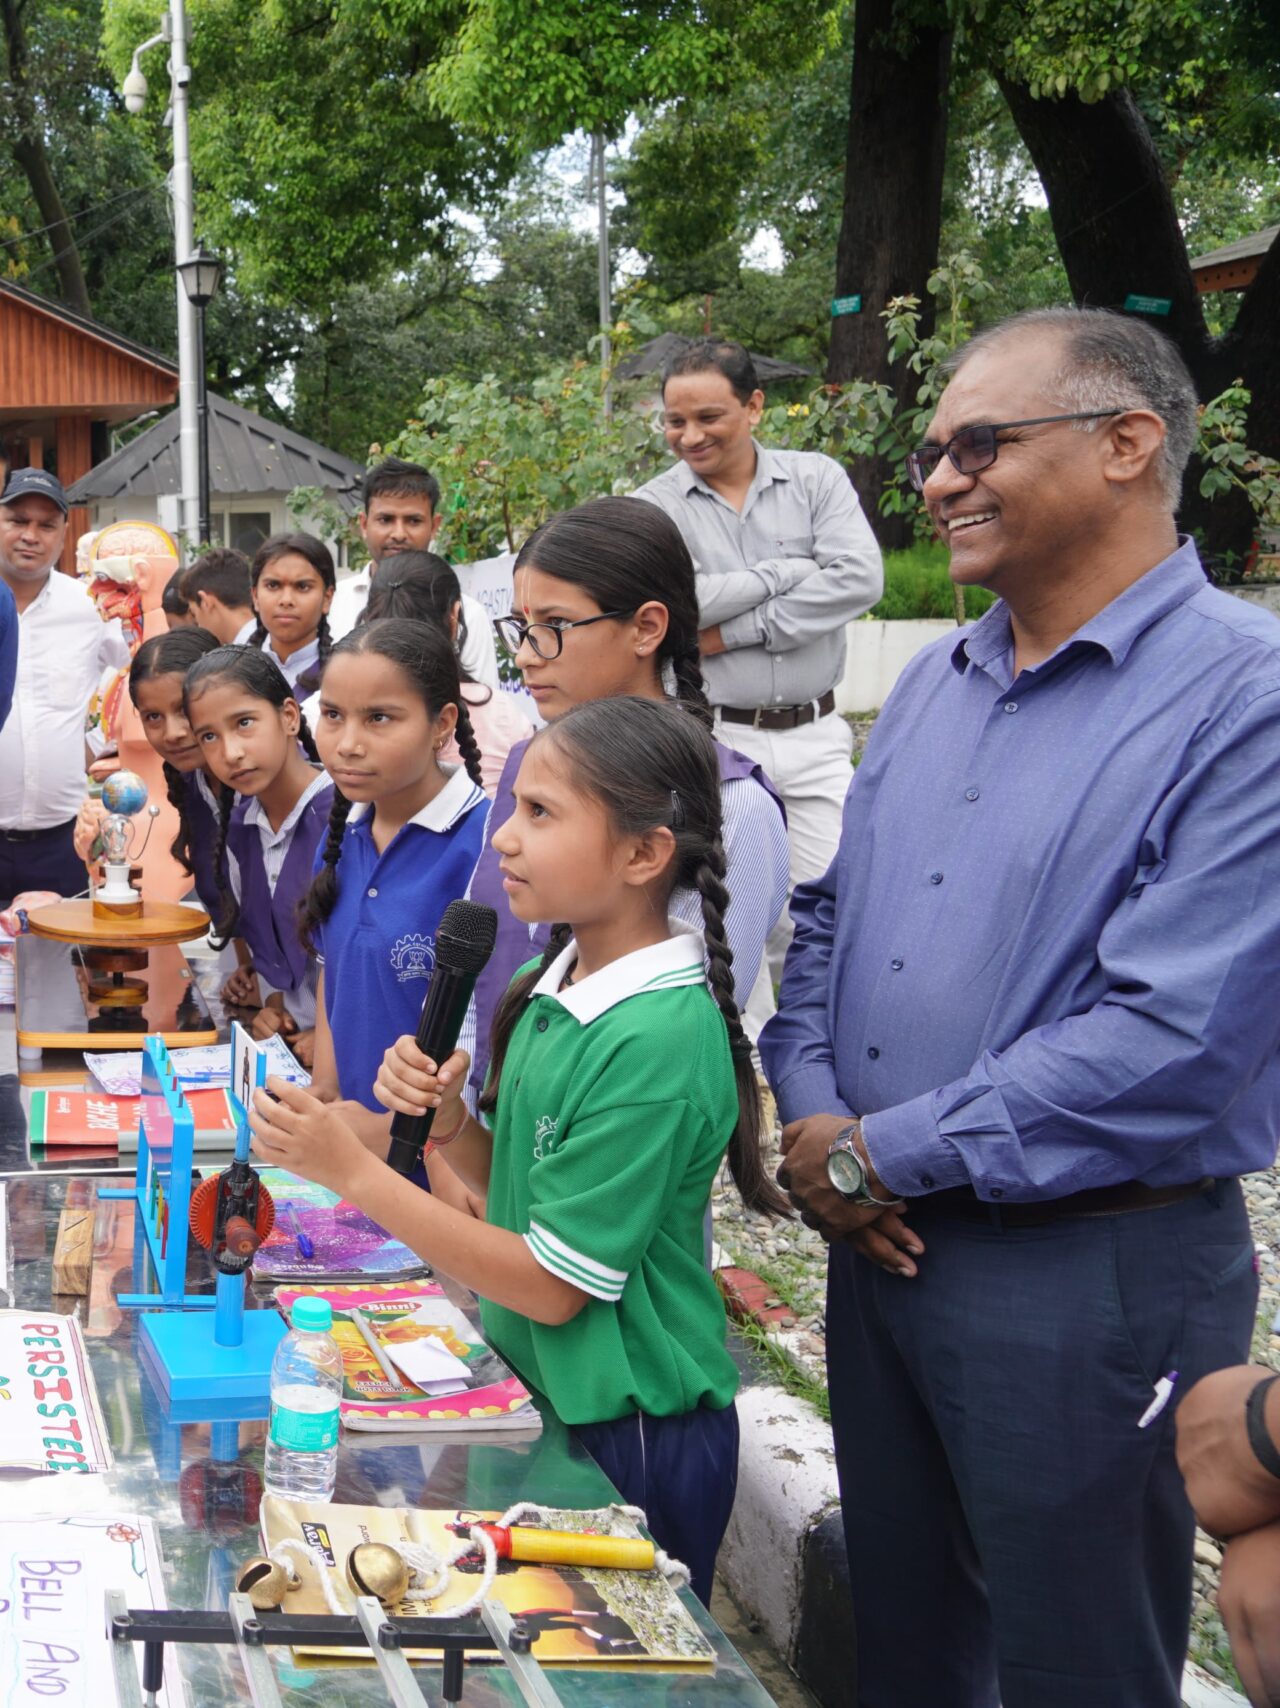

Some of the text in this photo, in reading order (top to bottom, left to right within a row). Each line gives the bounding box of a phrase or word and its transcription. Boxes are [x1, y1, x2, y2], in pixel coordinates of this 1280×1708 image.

[368, 1303, 416, 1311] Binni
[21, 1323, 89, 1473] PERSISTECE
[19, 1559, 82, 1697] BELL AND
